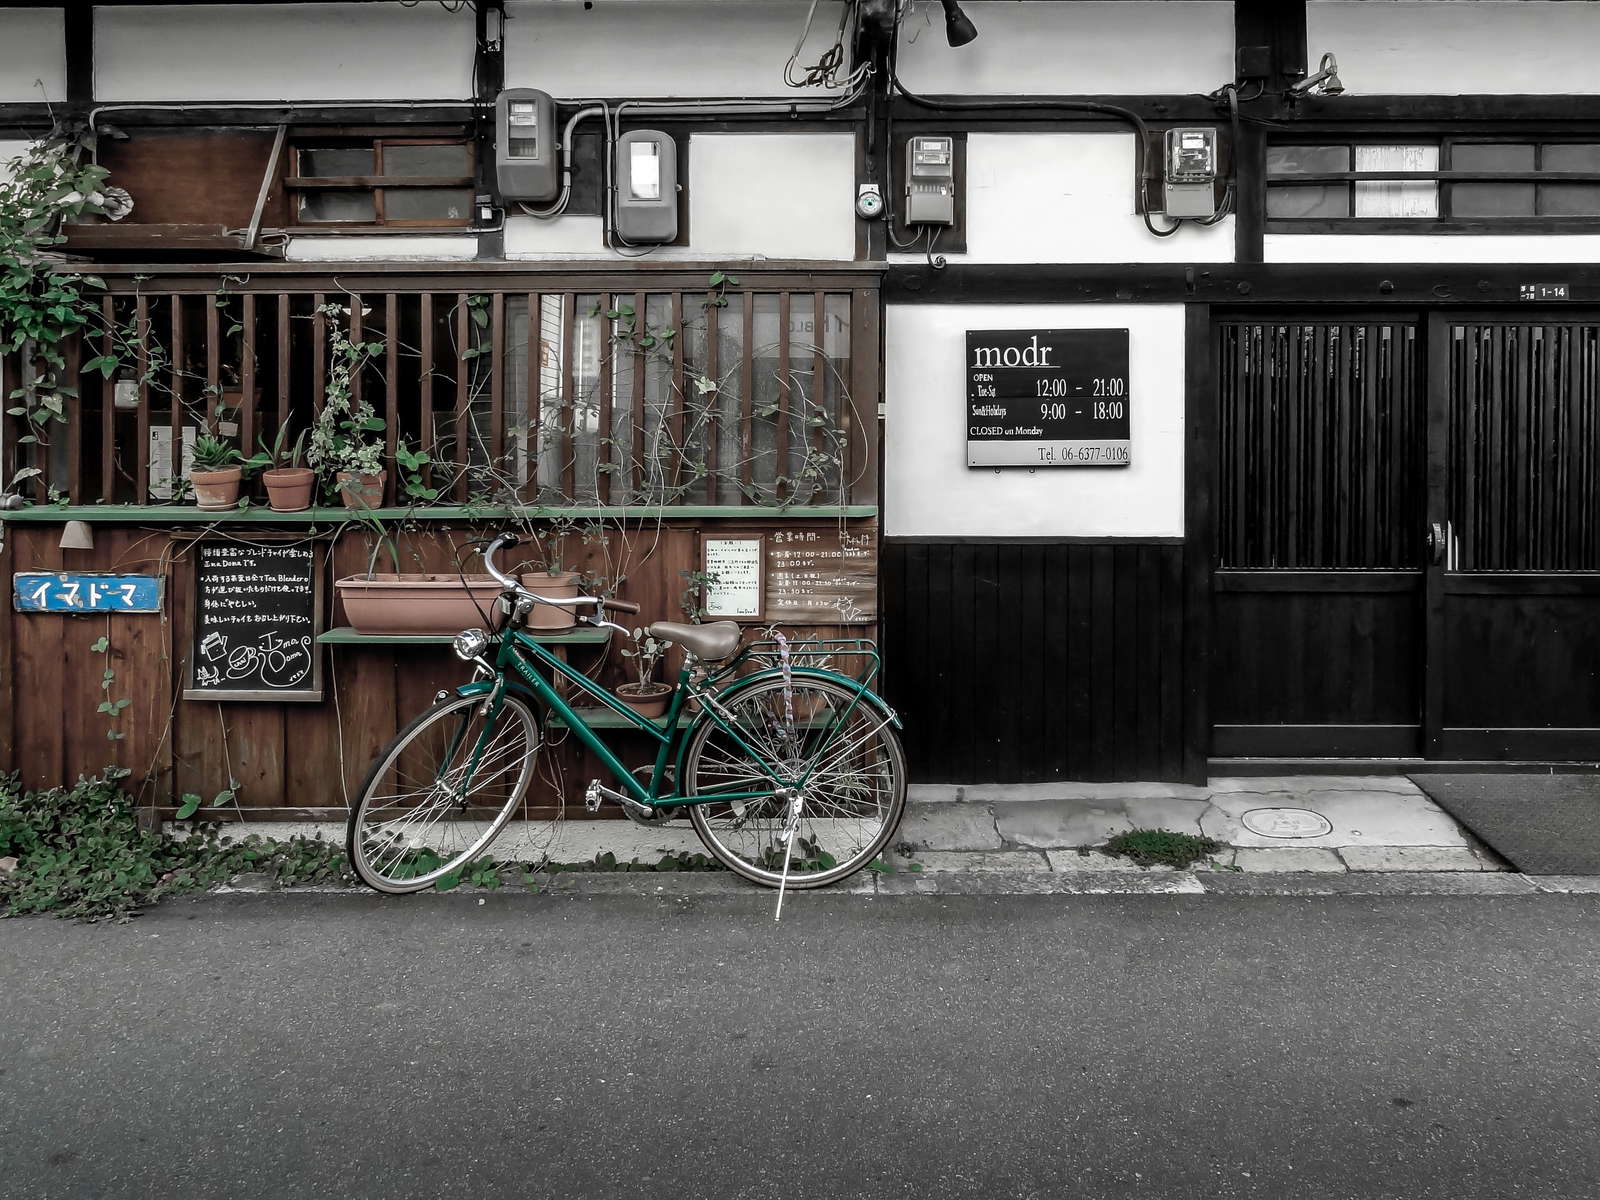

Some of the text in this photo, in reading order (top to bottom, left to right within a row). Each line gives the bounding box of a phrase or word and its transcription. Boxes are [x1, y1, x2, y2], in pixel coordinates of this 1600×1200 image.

[1541, 287, 1565, 297] 1-14
[973, 335, 1052, 367] modr
[973, 374, 993, 382] OPEN
[1036, 378, 1067, 397] 12:00
[1093, 378, 1124, 397] 21:00
[1040, 403, 1066, 420] 9:00
[1093, 401, 1123, 420] 18:00
[970, 426, 1044, 437] CLOSED on Monday
[1037, 446, 1128, 461] Tel. 06-6377-0106
[31, 581, 137, 608] イマドマ
